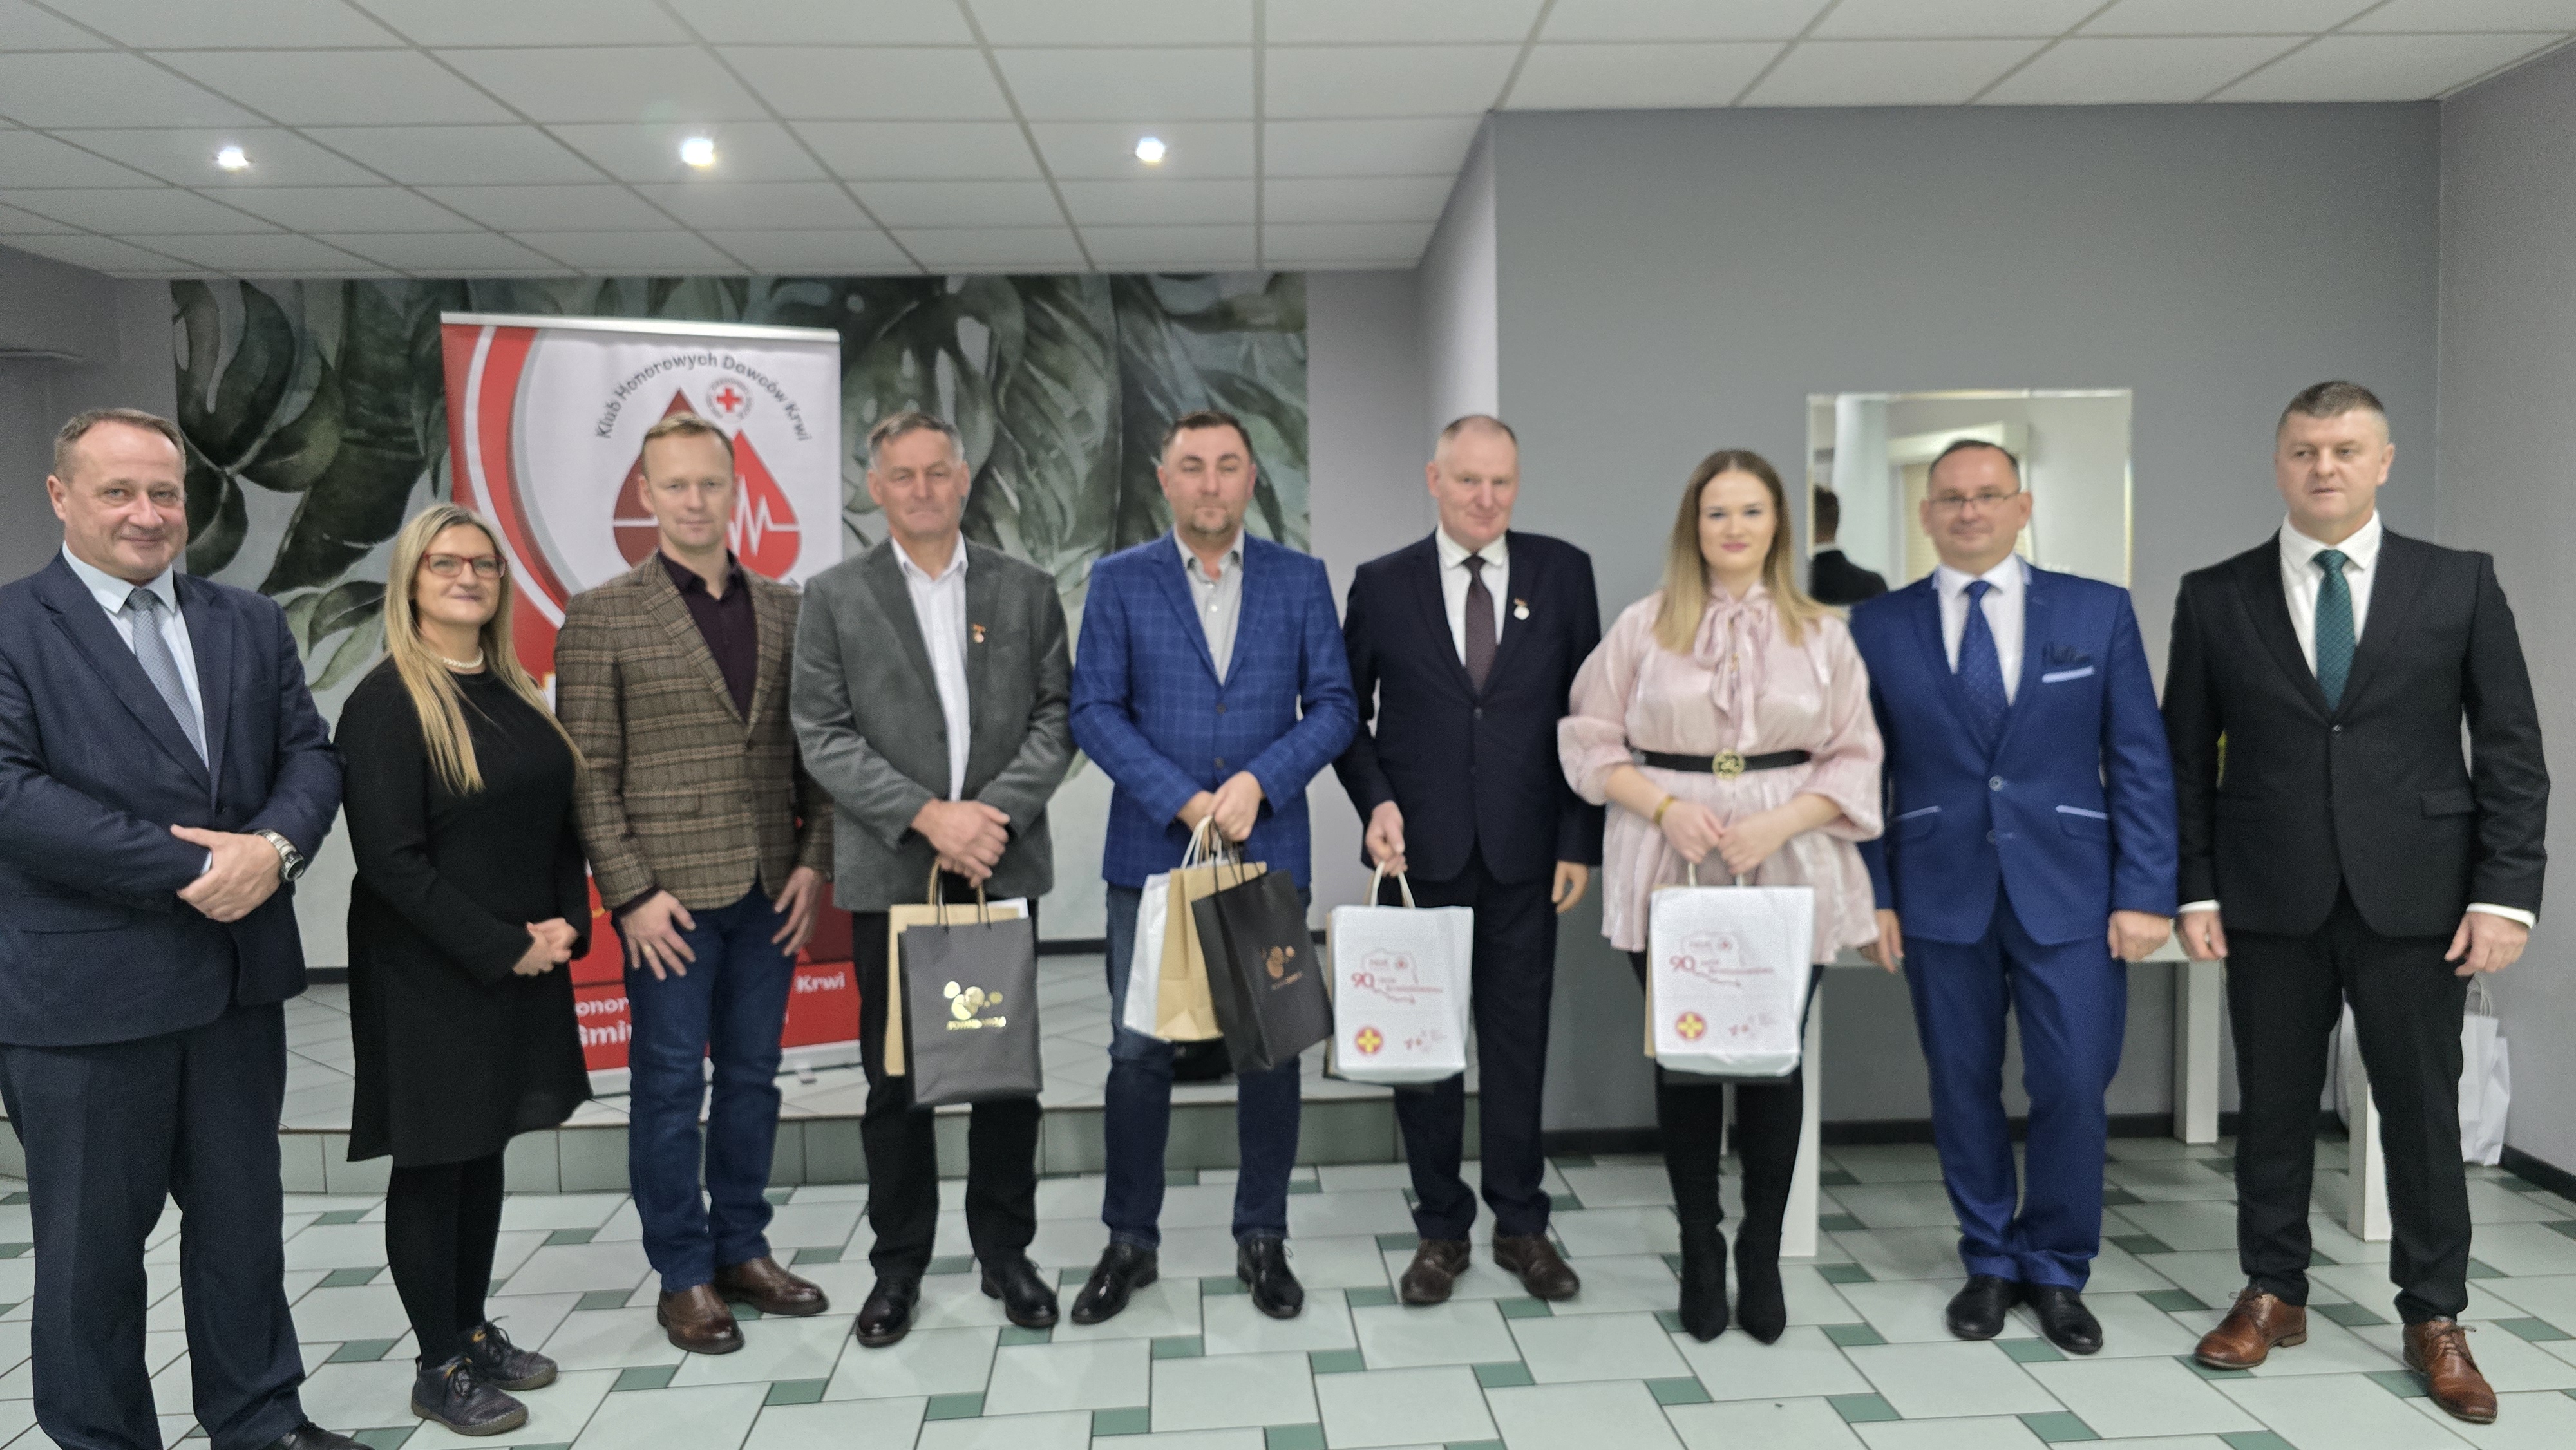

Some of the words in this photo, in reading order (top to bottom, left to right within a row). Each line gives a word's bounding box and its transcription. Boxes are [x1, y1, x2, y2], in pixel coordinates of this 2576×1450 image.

[596, 400, 622, 438] Klub
[614, 352, 718, 400] Honorowych
[784, 400, 813, 441] Krwi
[1669, 955, 1696, 972] 90
[574, 997, 629, 1017] onor
[795, 970, 846, 993] Krwi
[1351, 972, 1375, 988] 90
